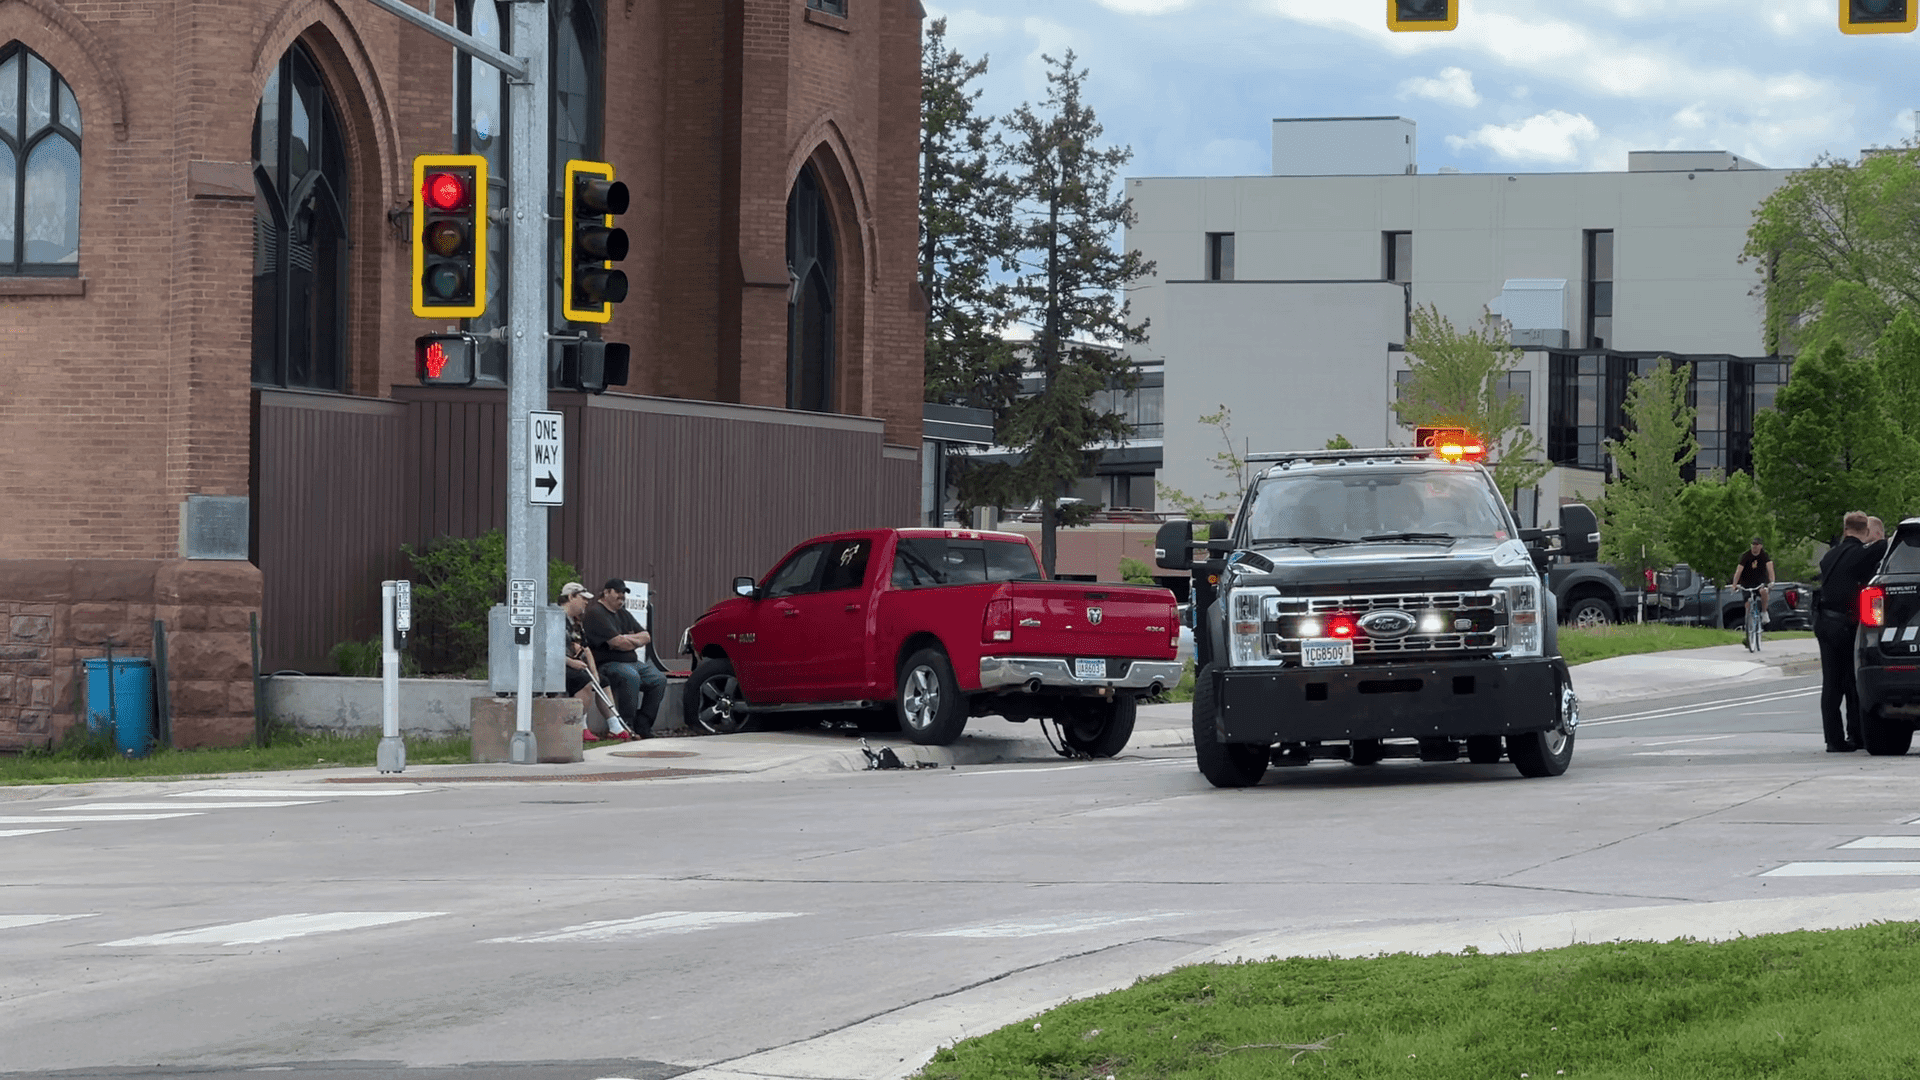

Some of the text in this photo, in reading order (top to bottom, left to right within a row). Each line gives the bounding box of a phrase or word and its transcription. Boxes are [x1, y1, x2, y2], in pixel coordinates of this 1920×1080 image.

[535, 419, 557, 440] ONE
[535, 444, 558, 465] WAY
[1373, 617, 1400, 630] Ford
[1305, 647, 1344, 661] YCG8509
